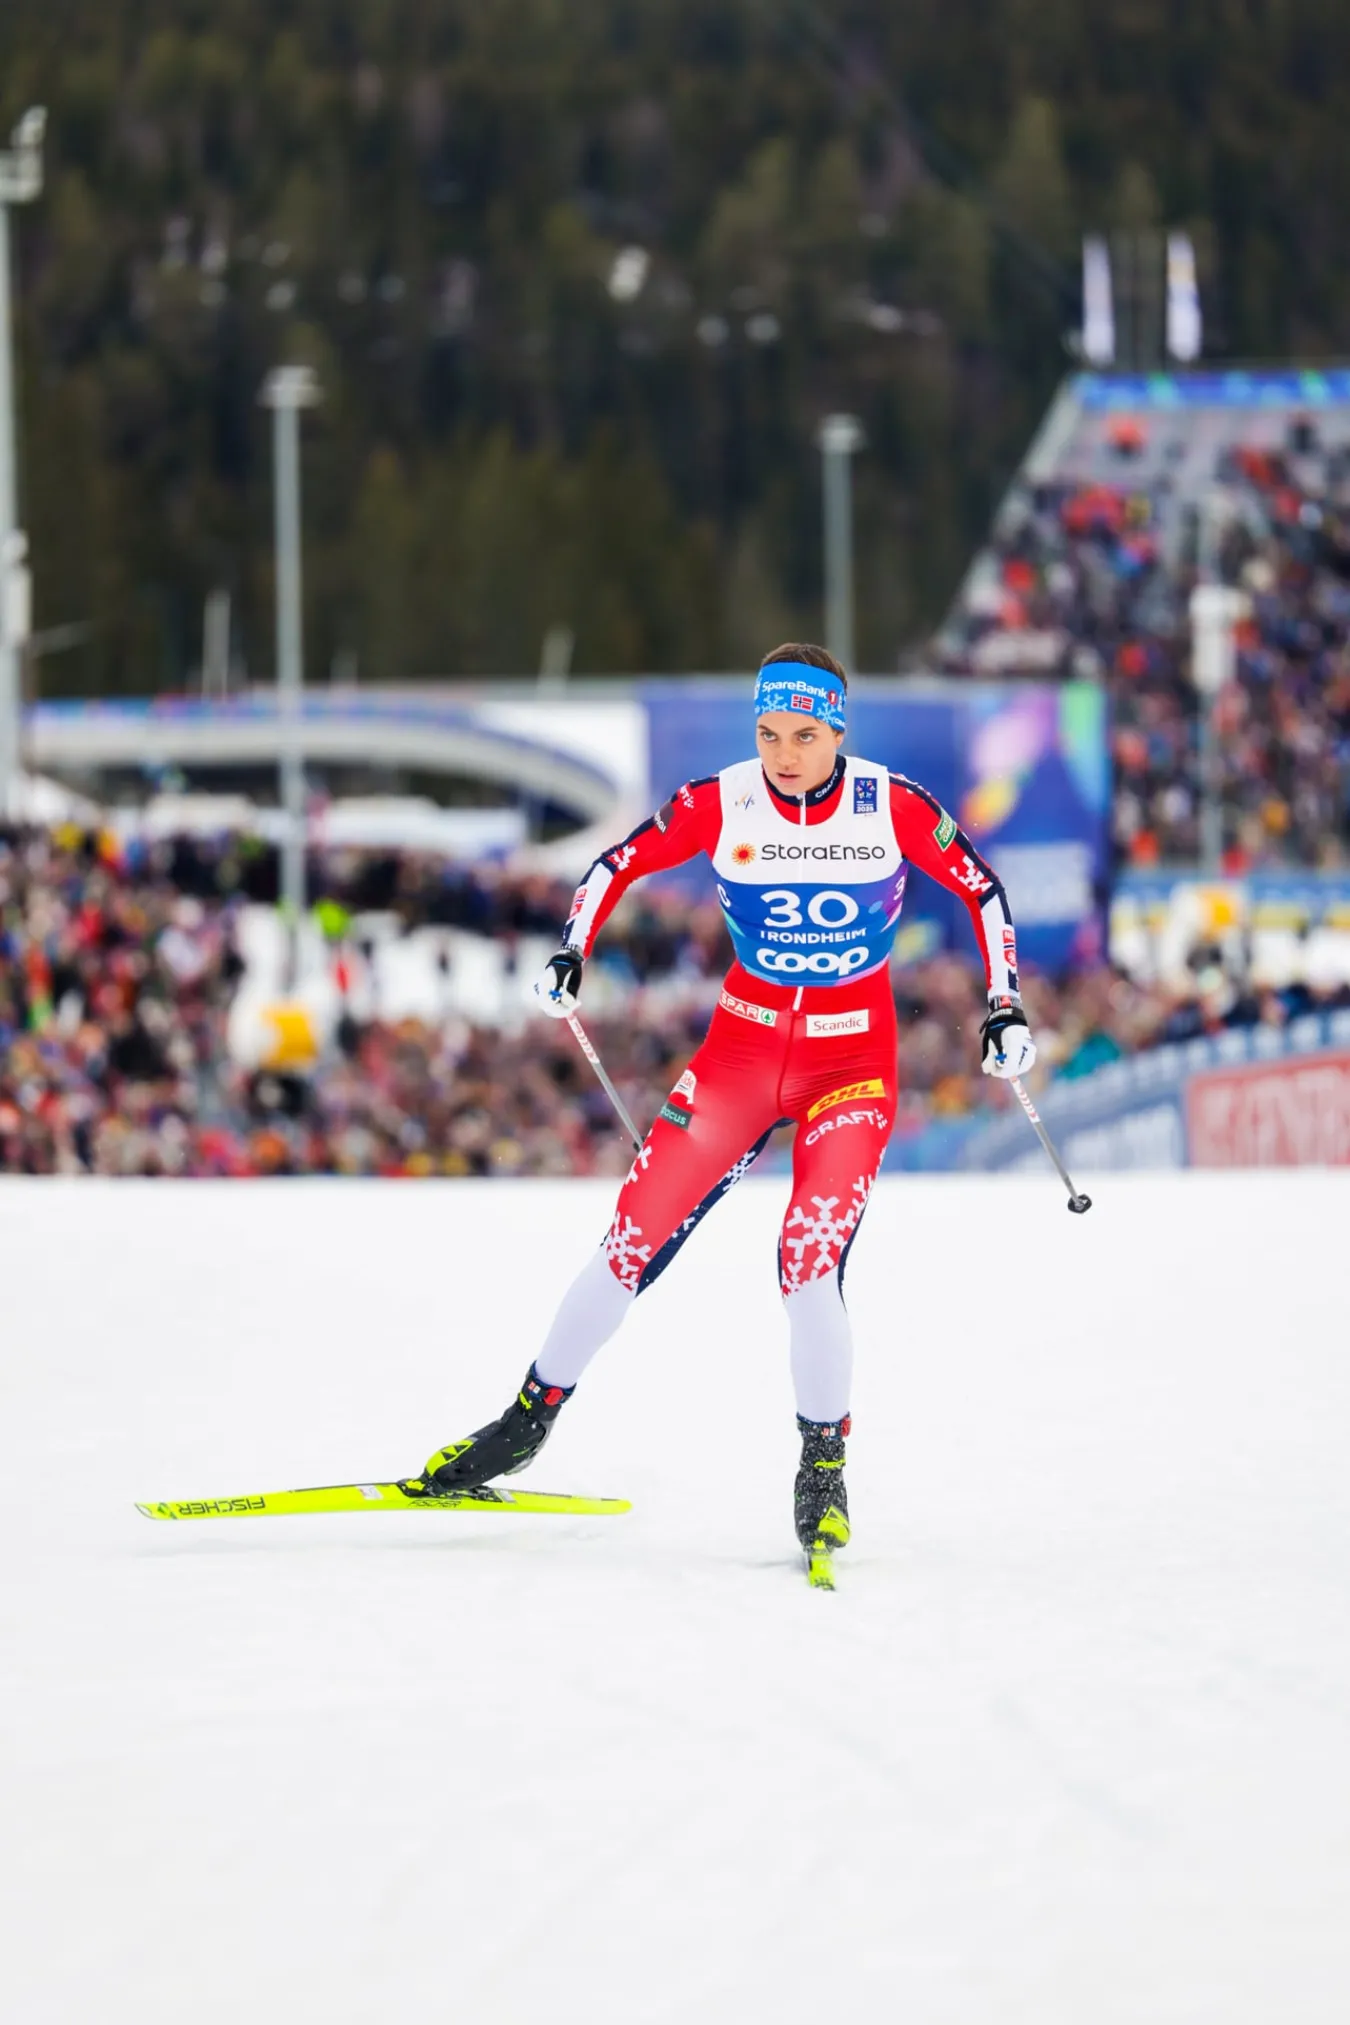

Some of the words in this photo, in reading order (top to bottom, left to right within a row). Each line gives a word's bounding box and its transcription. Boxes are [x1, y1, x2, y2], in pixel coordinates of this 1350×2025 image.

[762, 681, 828, 699] SpareBank
[761, 844, 885, 860] StoraEnso
[760, 889, 859, 928] 30
[756, 946, 870, 977] coop
[721, 992, 759, 1019] SPAR
[813, 1017, 863, 1032] Scandic
[817, 1084, 875, 1111] DHL
[805, 1110, 875, 1146] CRAFT
[178, 1496, 266, 1516] FISCHER
